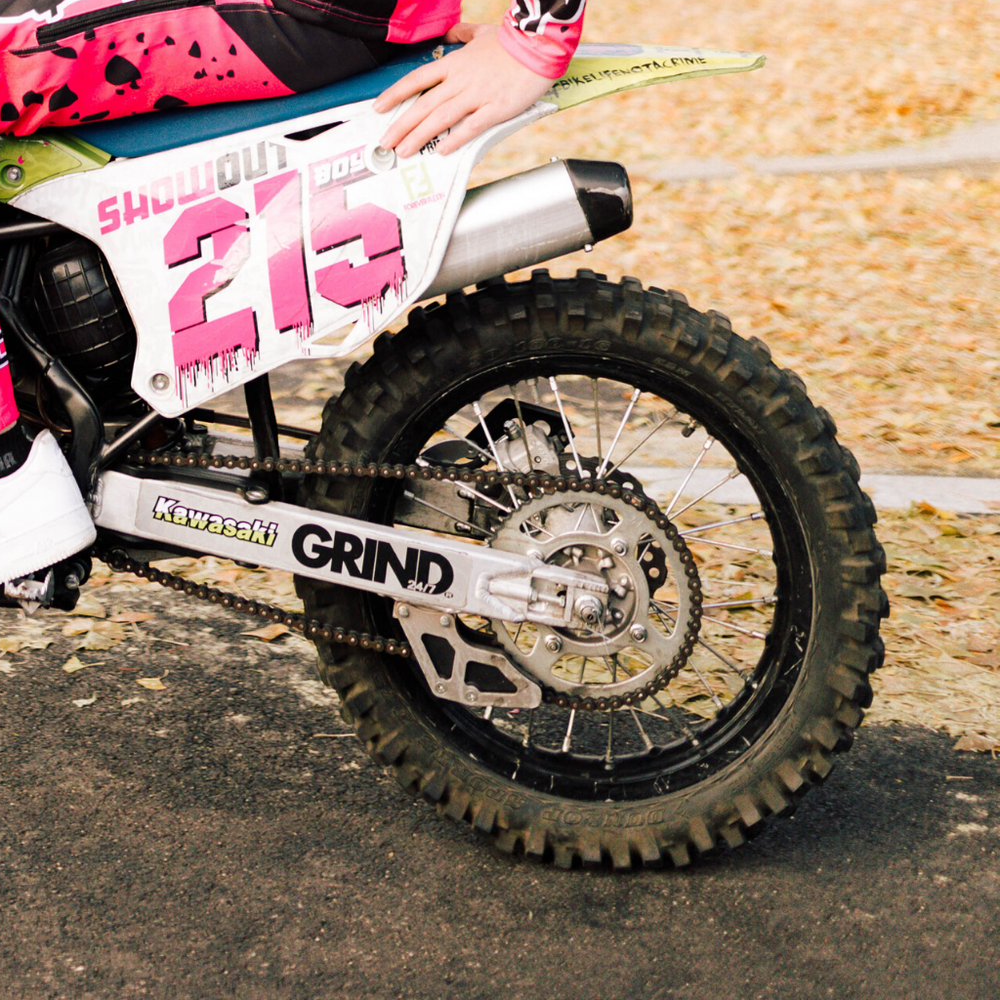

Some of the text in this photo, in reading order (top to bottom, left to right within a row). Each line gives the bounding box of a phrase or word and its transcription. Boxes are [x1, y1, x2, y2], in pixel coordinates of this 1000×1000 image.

[152, 495, 279, 547] Kawasaki
[291, 523, 454, 596] GRIND
[407, 579, 437, 594] 24/7
